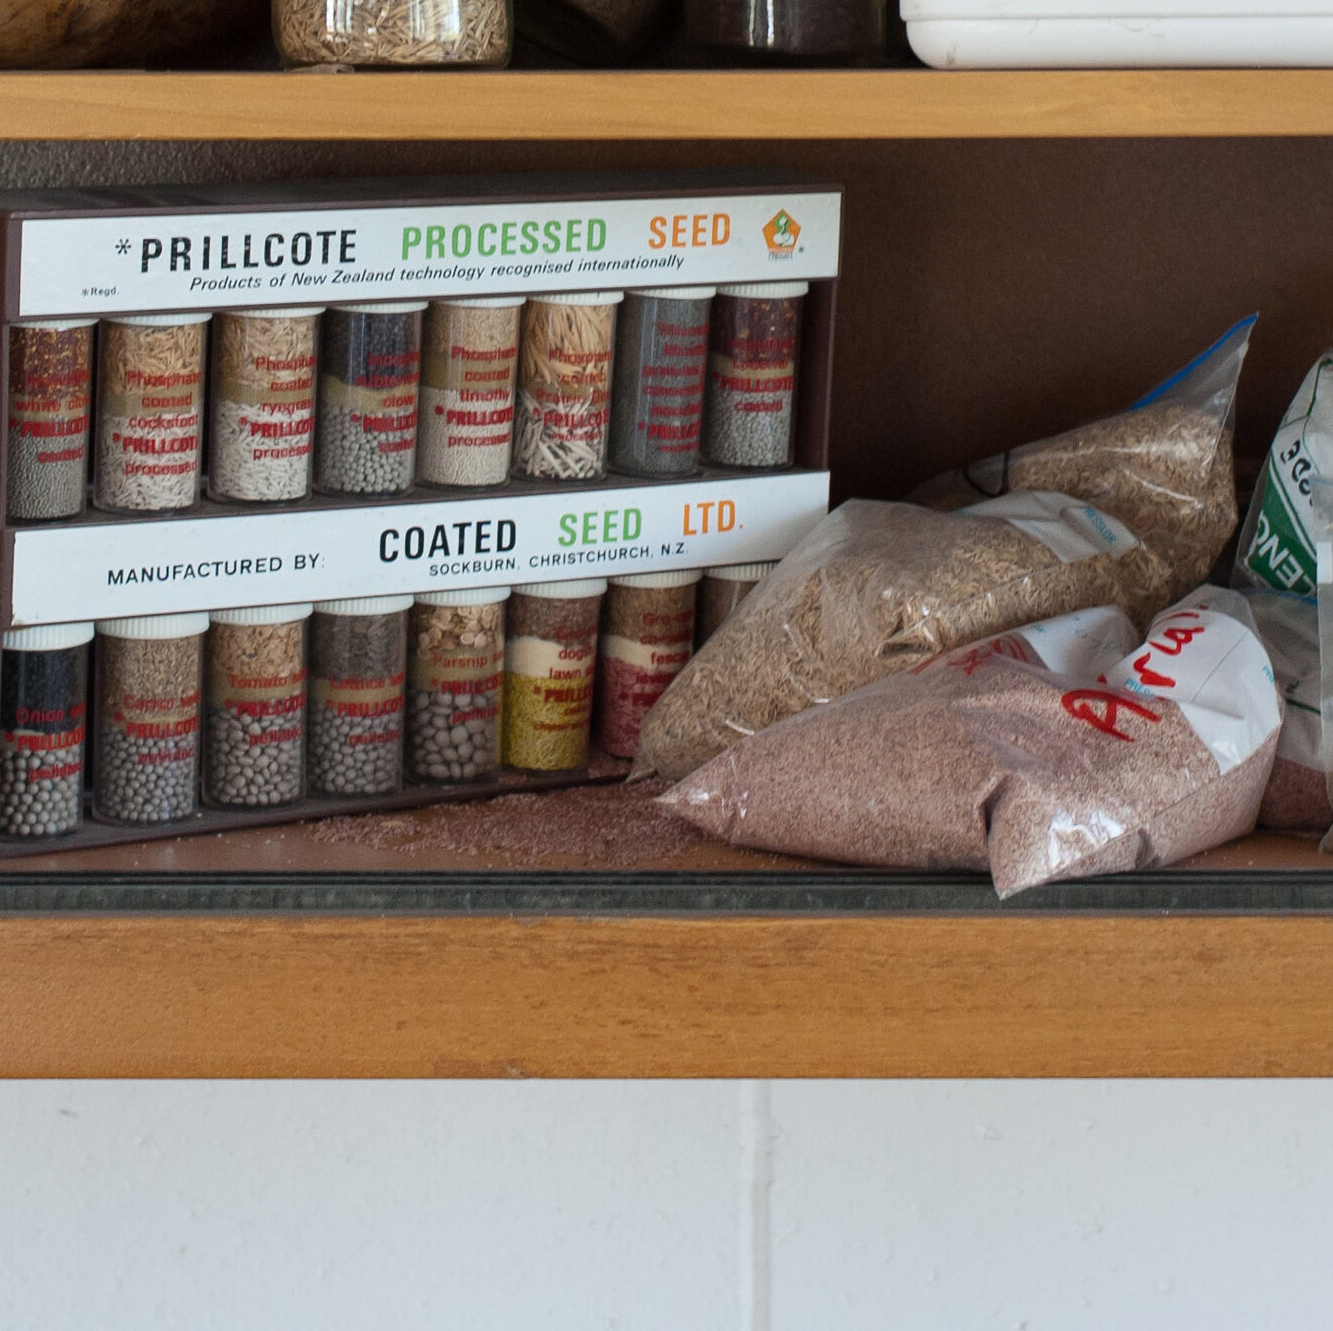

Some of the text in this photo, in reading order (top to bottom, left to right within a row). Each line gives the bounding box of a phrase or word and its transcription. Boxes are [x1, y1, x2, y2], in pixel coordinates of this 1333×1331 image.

[401, 218, 607, 262] PROCESSED
[648, 213, 731, 250] SEED
[189, 253, 685, 292] Products of New Zealand technology recognised internationally
[141, 392, 193, 409] coated
[379, 500, 744, 564] COATED SEED LTD.
[107, 556, 283, 586] MANUFACTURED
[229, 674, 288, 690] Tomato
[549, 666, 582, 681] lawn
[16, 707, 65, 724] Onion
